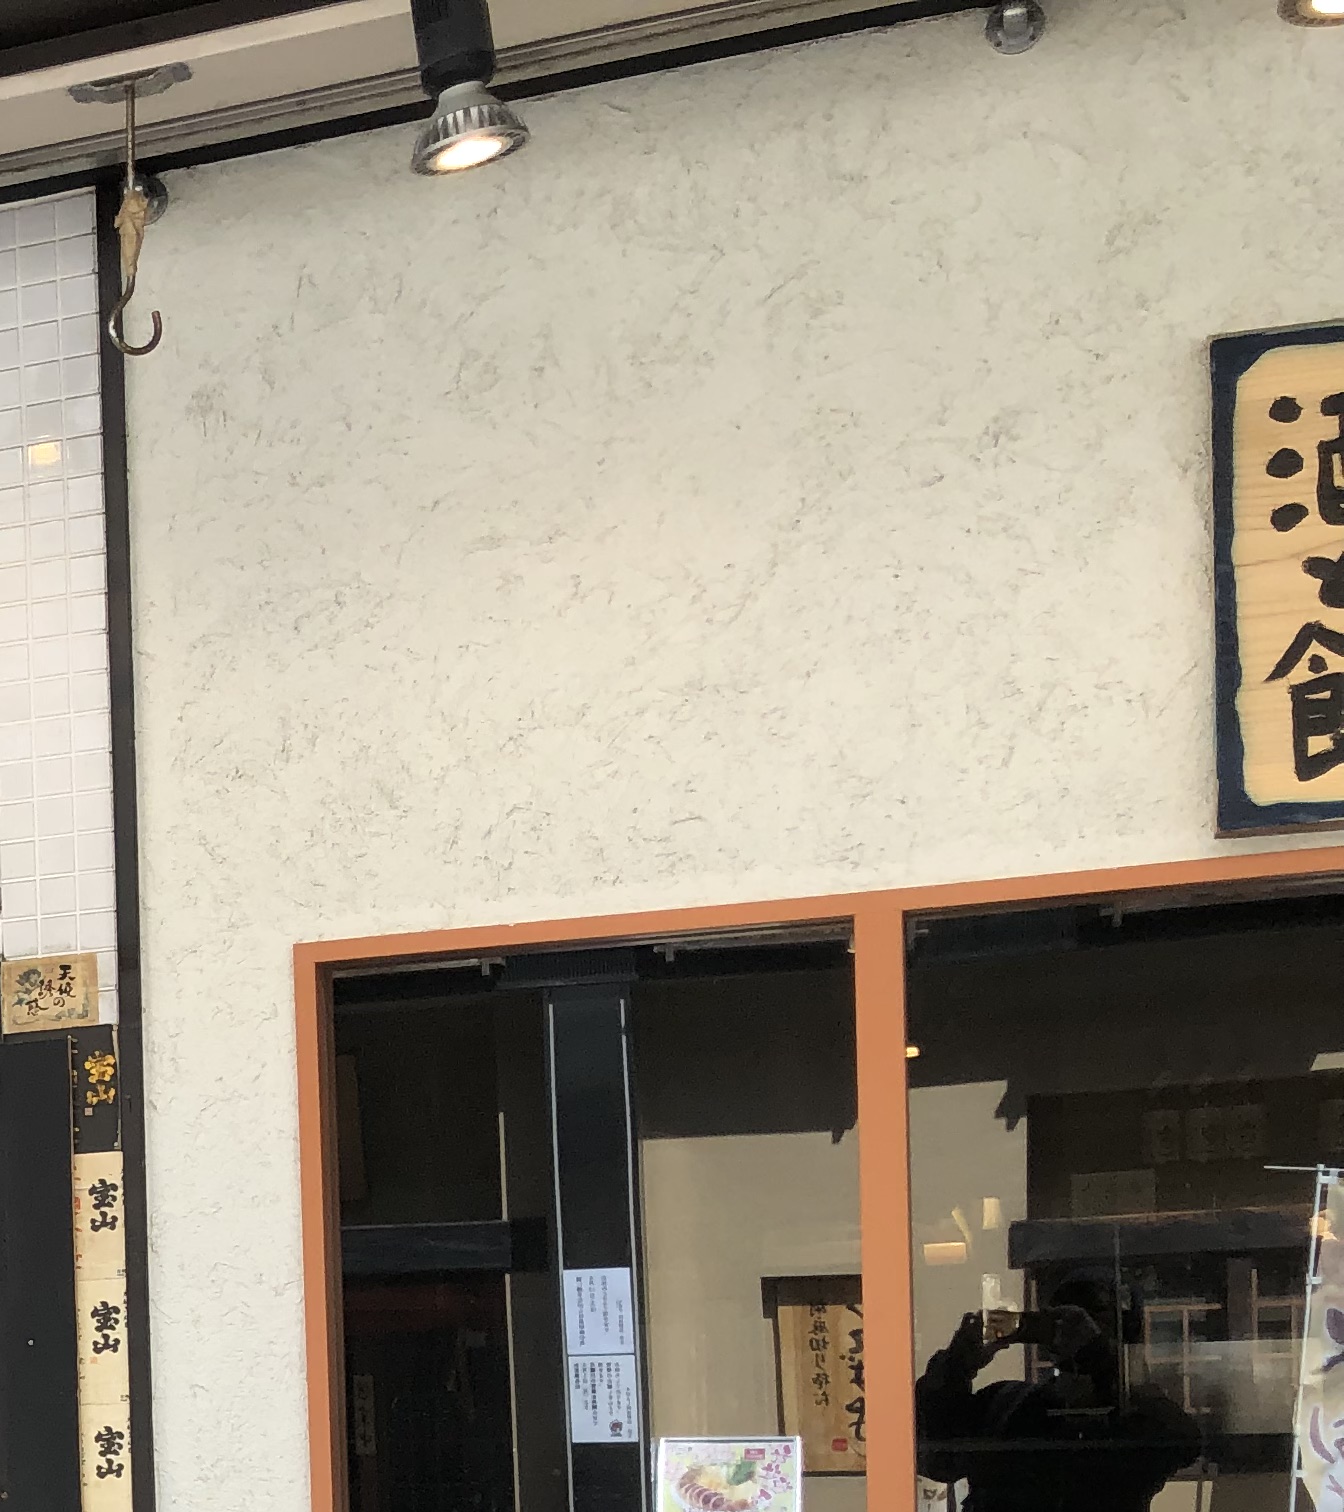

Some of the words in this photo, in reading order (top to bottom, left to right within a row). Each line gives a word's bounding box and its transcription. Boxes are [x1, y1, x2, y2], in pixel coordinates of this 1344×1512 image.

[88, 1179, 119, 1233] 宝山
[90, 1301, 121, 1354] 宝山
[94, 1426, 125, 1479] 宝山
